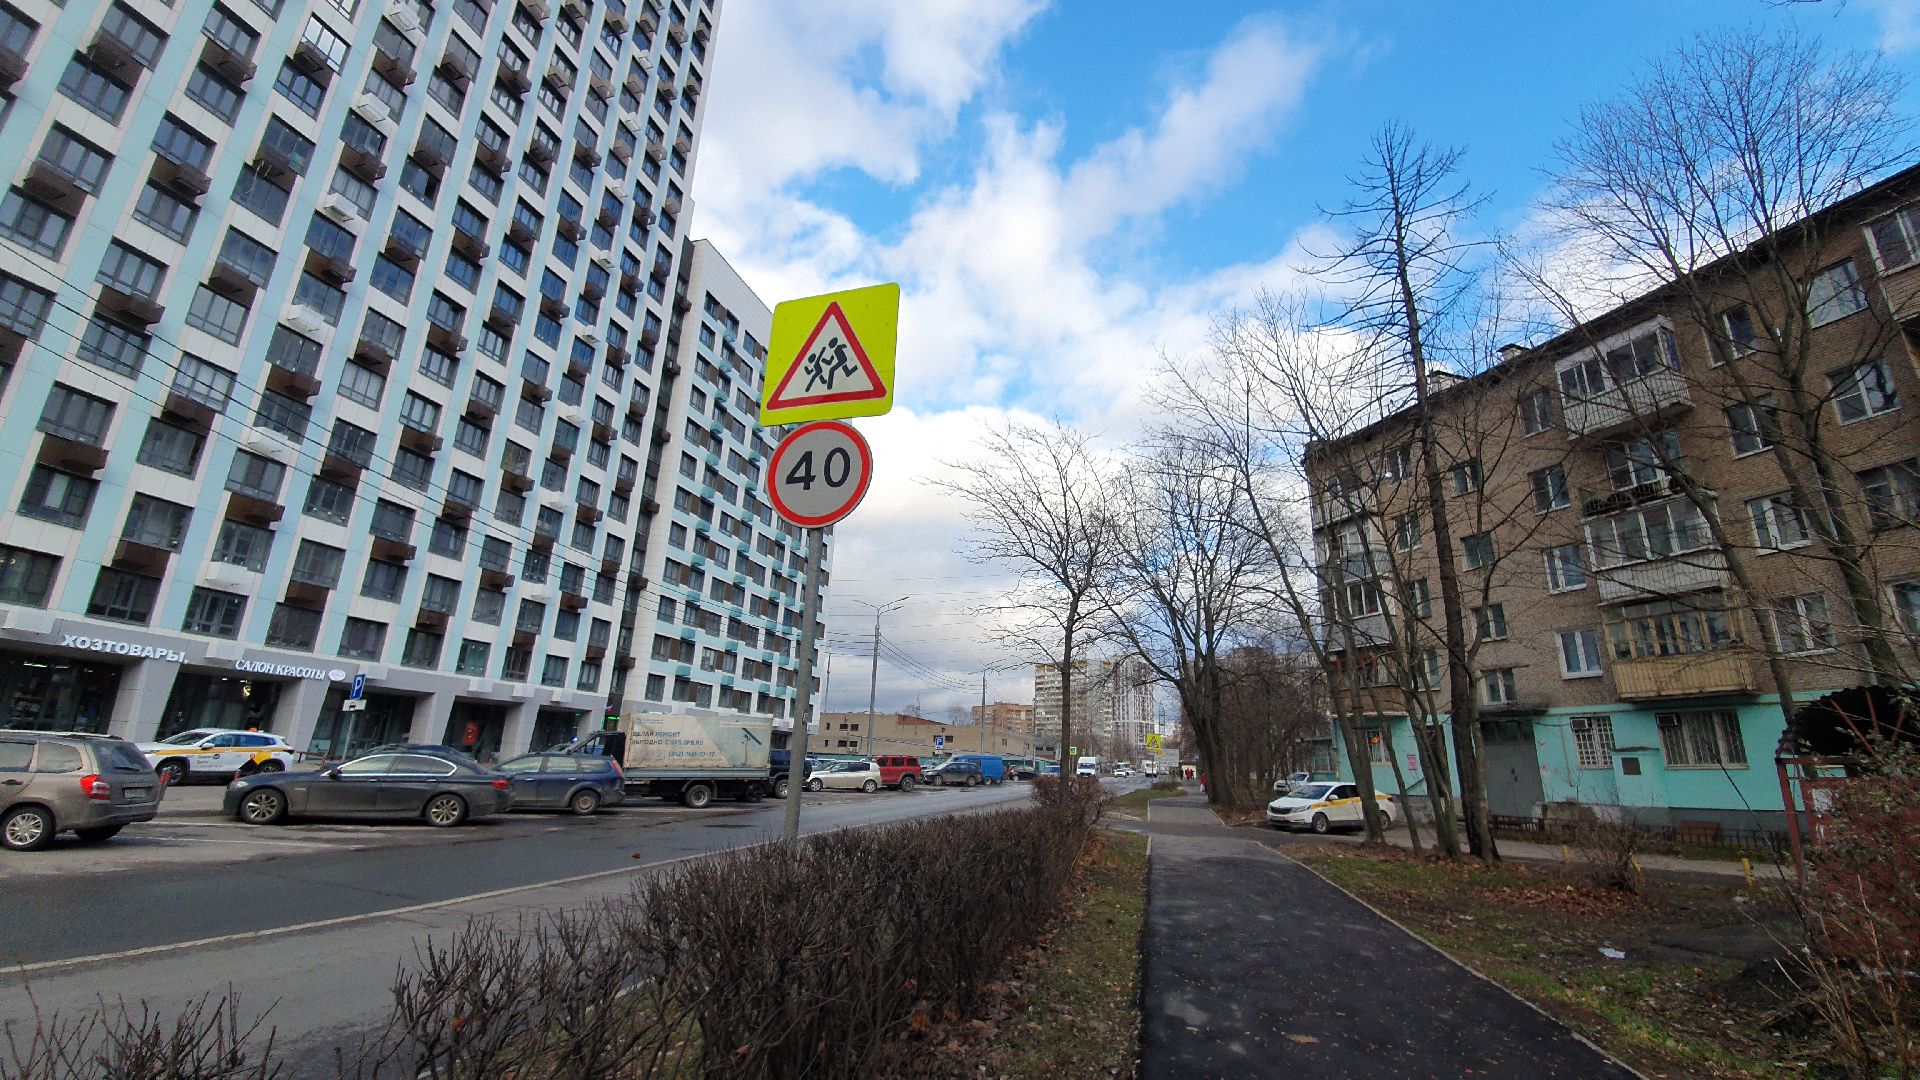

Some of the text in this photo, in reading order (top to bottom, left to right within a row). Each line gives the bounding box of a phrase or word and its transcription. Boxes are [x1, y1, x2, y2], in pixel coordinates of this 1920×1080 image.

[786, 447, 850, 490] 40
[235, 660, 273, 675] САЛОН
[276, 664, 326, 680] КРАСОТЫ
[353, 676, 362, 697] P
